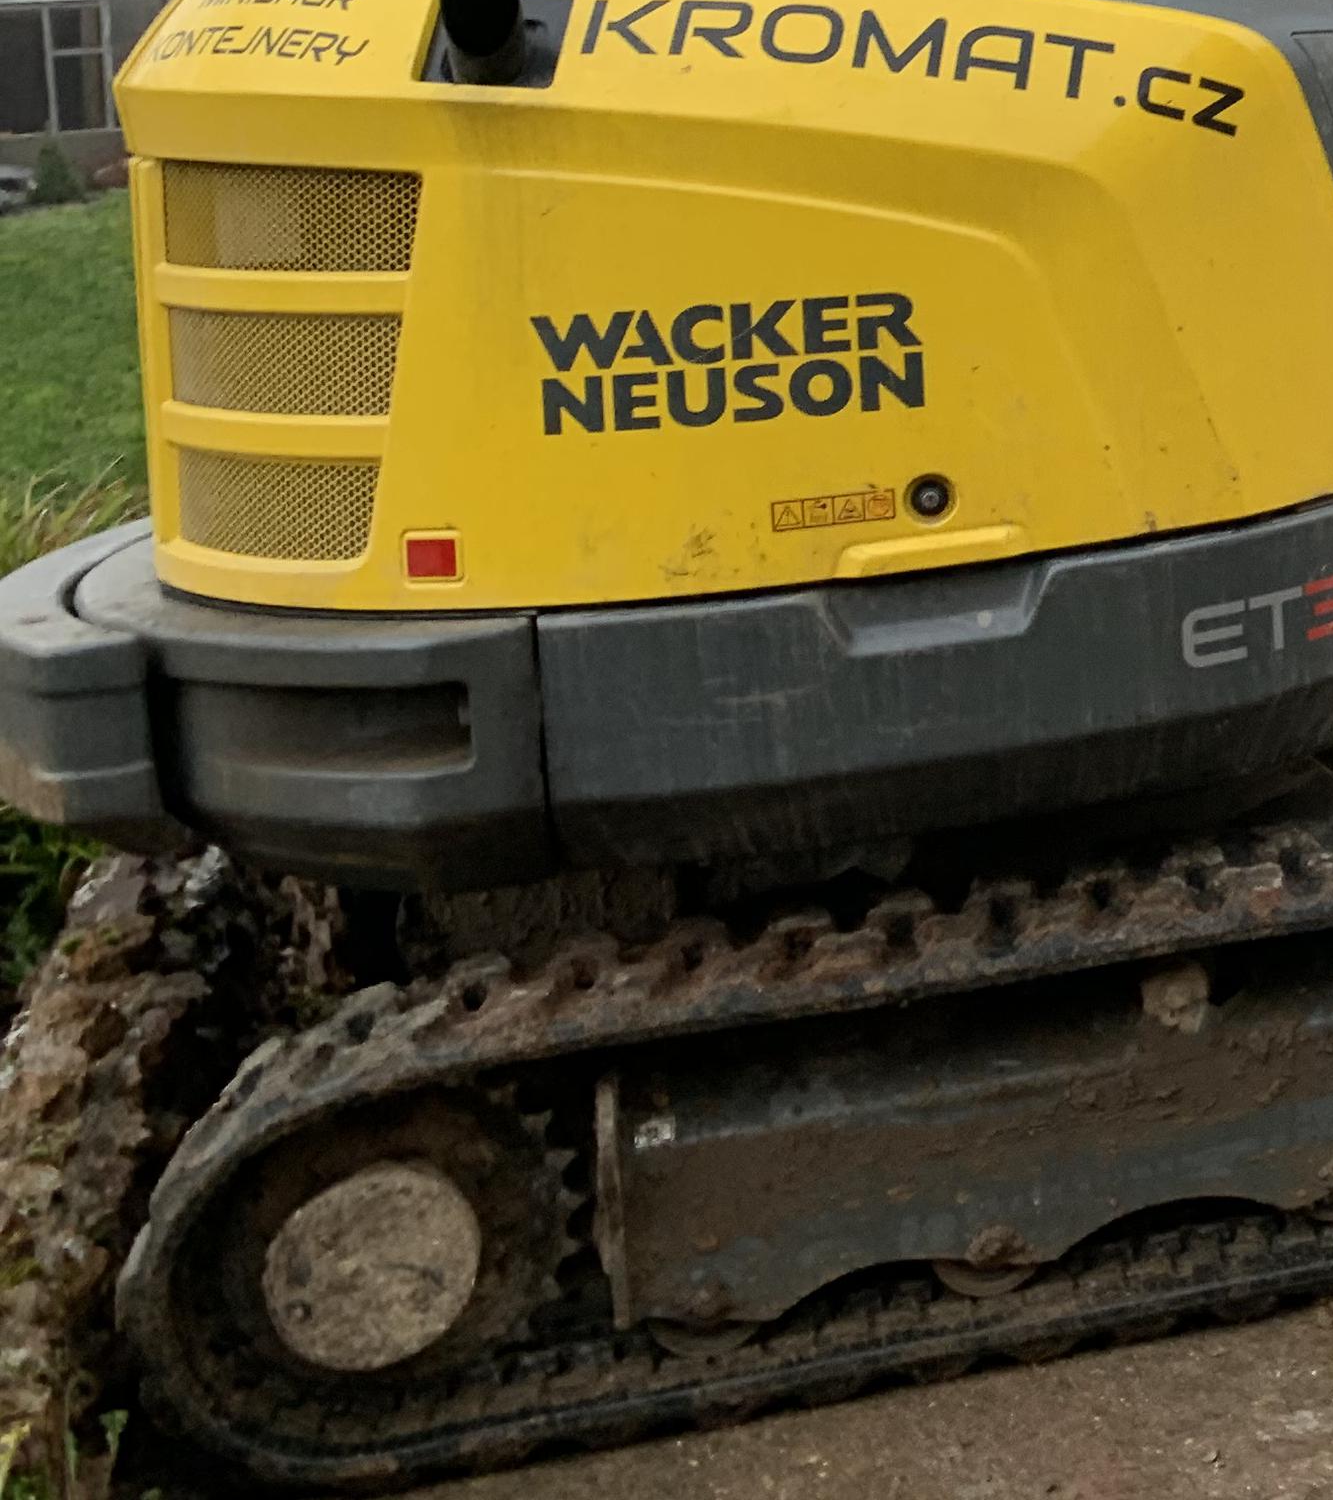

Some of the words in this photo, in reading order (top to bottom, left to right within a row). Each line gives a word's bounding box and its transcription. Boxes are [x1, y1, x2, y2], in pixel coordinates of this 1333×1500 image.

[152, 25, 370, 66] KONTEJNERY
[530, 292, 924, 372] WACKER
[541, 352, 926, 436] NEUSON
